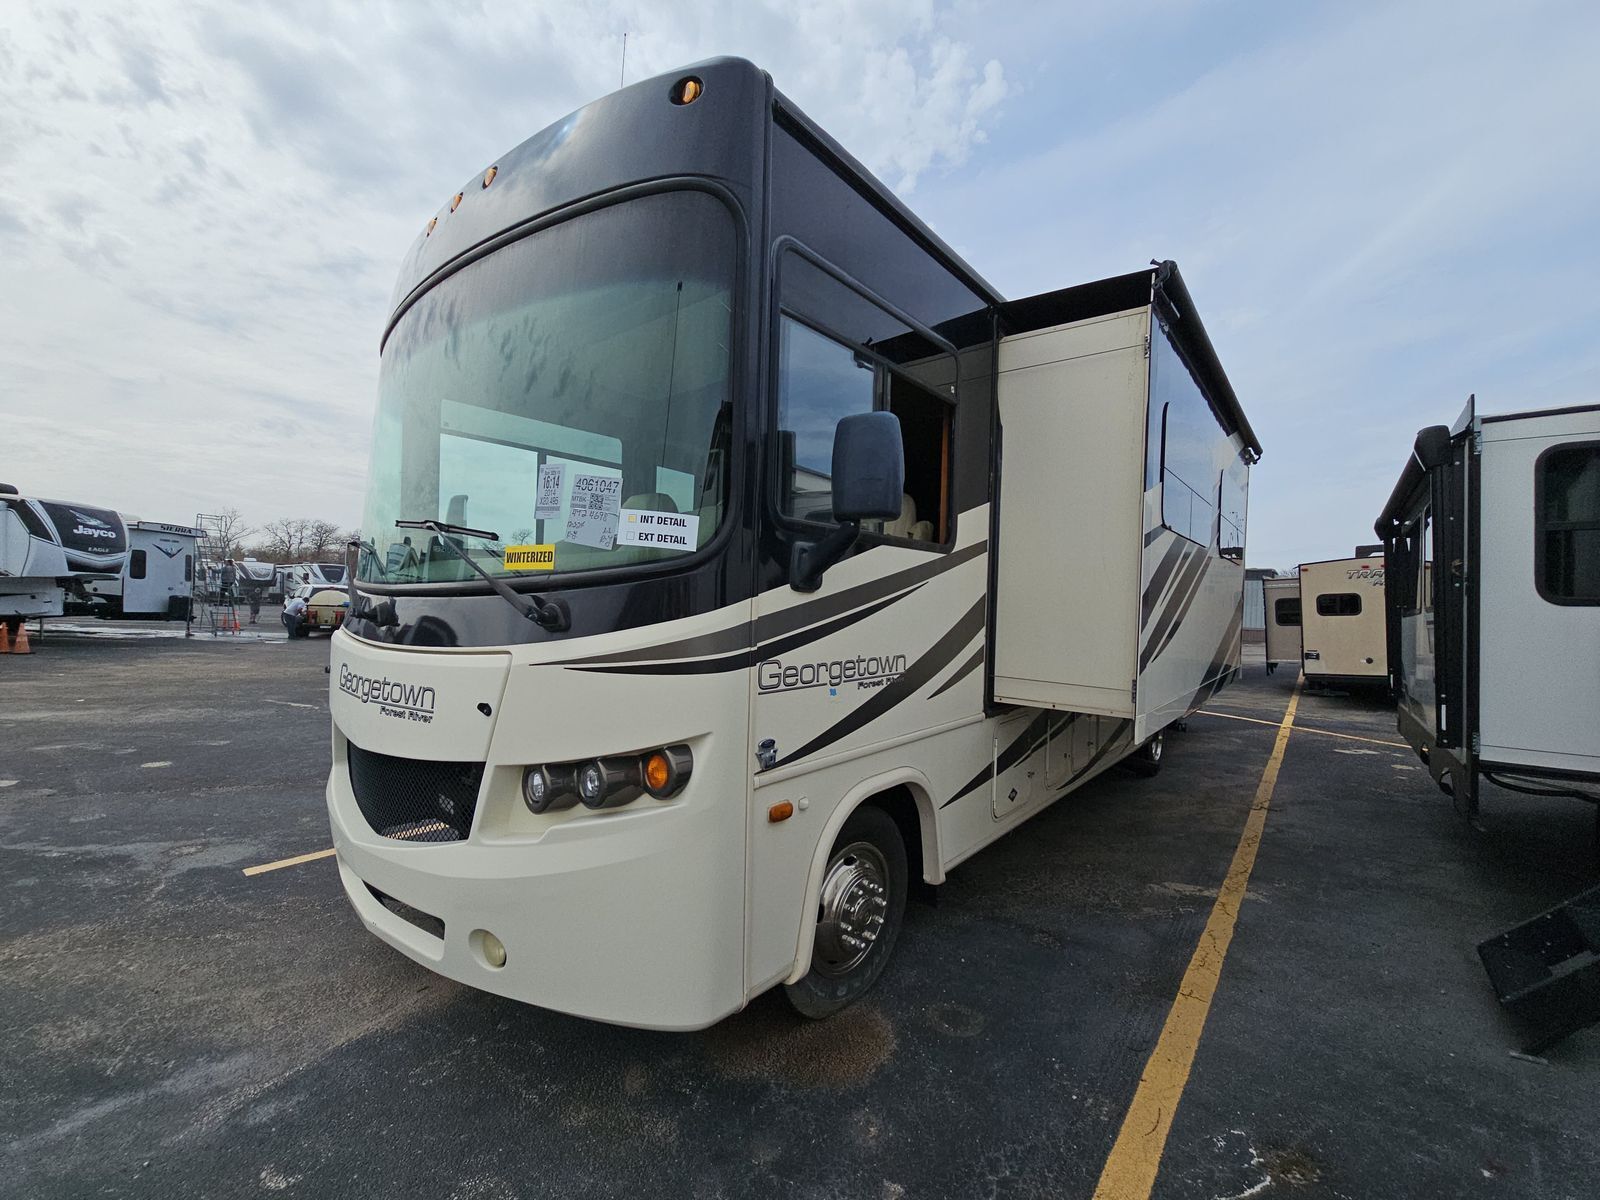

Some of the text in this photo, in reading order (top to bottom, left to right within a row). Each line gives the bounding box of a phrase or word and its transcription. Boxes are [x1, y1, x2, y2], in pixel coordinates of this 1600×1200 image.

[575, 478, 620, 494] 4061047
[640, 515, 687, 528] INT DETAIL
[73, 525, 116, 538] Jayco
[638, 532, 687, 545] EXT DETAIL
[506, 551, 553, 563] WINTERIZED
[1347, 569, 1385, 579] TRA
[758, 654, 906, 690] Georgetown
[339, 663, 435, 709] Georgetown
[858, 678, 884, 690] Forest
[380, 705, 433, 724] Forest River
